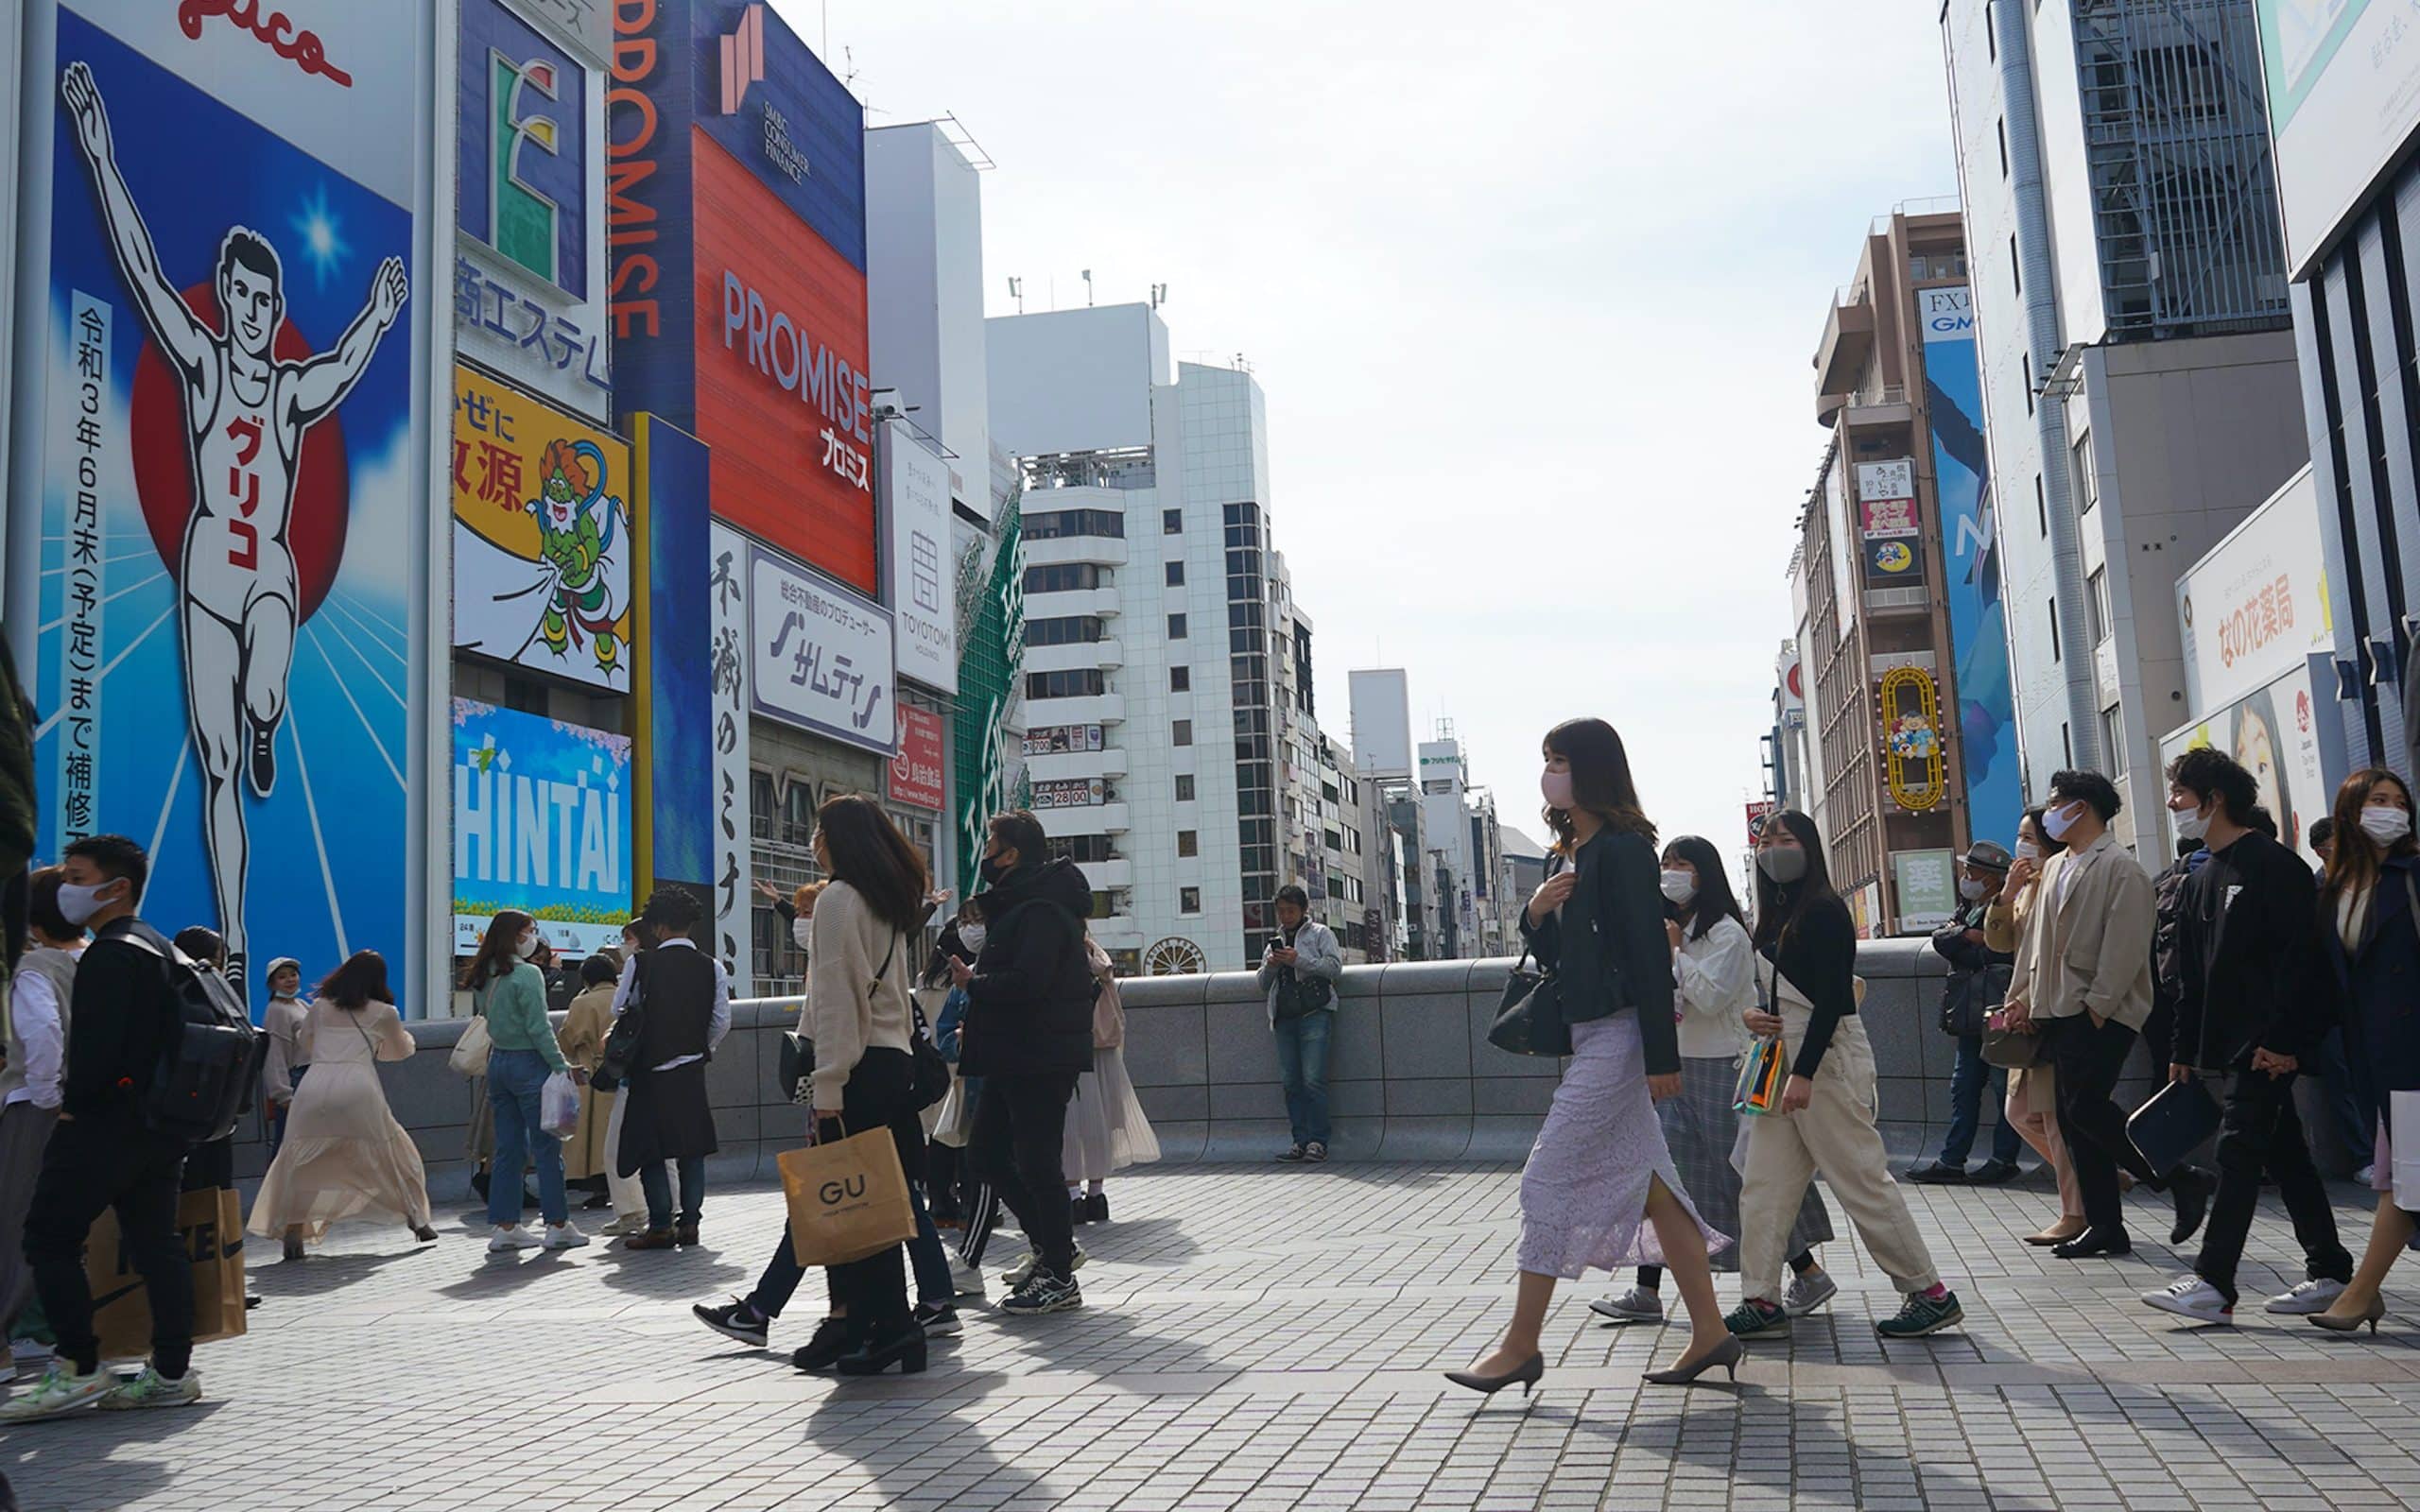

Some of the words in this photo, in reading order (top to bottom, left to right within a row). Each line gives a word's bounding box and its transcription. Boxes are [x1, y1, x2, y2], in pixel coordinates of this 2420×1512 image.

[764, 120, 810, 177] CONSUMER
[765, 139, 802, 186] FINANCE
[724, 270, 869, 446] PROMISE
[455, 389, 515, 443] ぜに
[820, 426, 870, 492] プロミス
[226, 416, 266, 571] グリコ
[780, 578, 876, 636] 総合不動産のプロデューサー
[2219, 574, 2293, 668] なの花薬局
[790, 639, 864, 706] サムティ
[820, 1174, 866, 1205] GU
